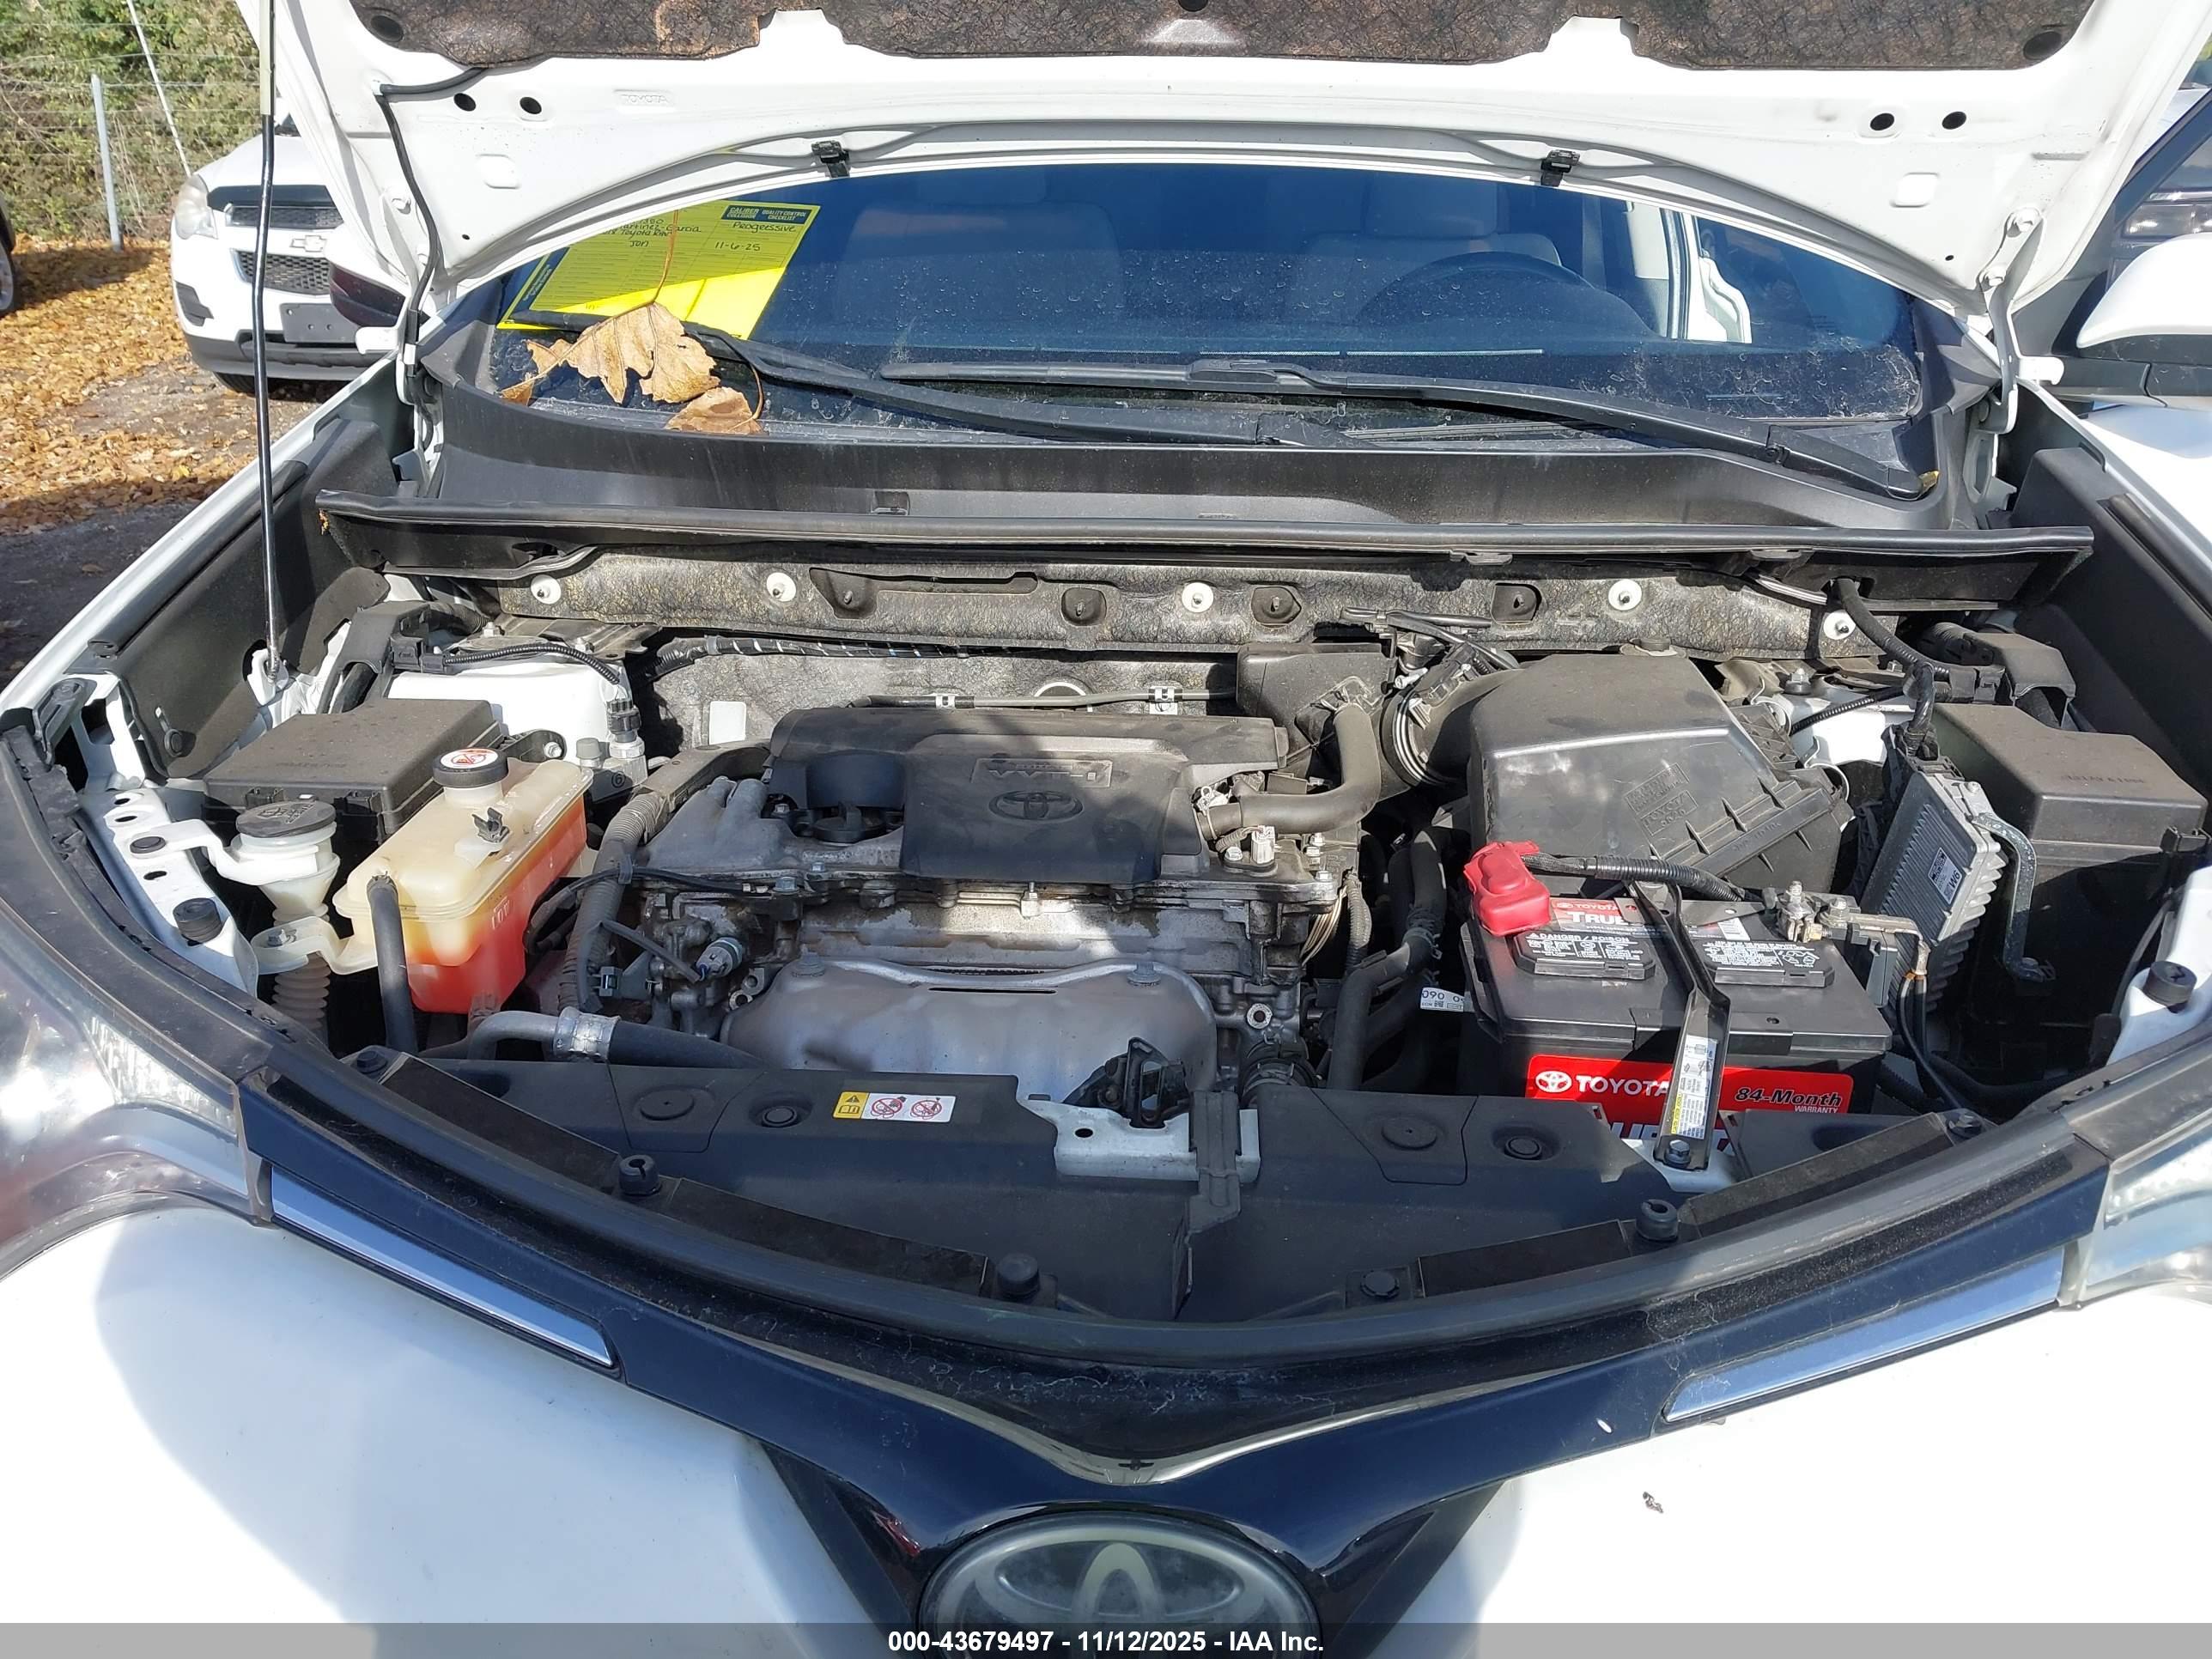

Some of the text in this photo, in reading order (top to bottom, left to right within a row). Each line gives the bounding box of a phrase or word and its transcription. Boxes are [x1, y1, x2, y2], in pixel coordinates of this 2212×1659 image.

[620, 94, 669, 104] TOYOTA
[714, 241, 762, 252] 11-6-25
[1566, 911, 1629, 926] TRUE
[1540, 933, 1582, 941] DANGER
[1575, 1074, 1669, 1097] TOYOTA
[1735, 1086, 1843, 1108] 84-Month
[1794, 1105, 1838, 1114] WARRANTY
